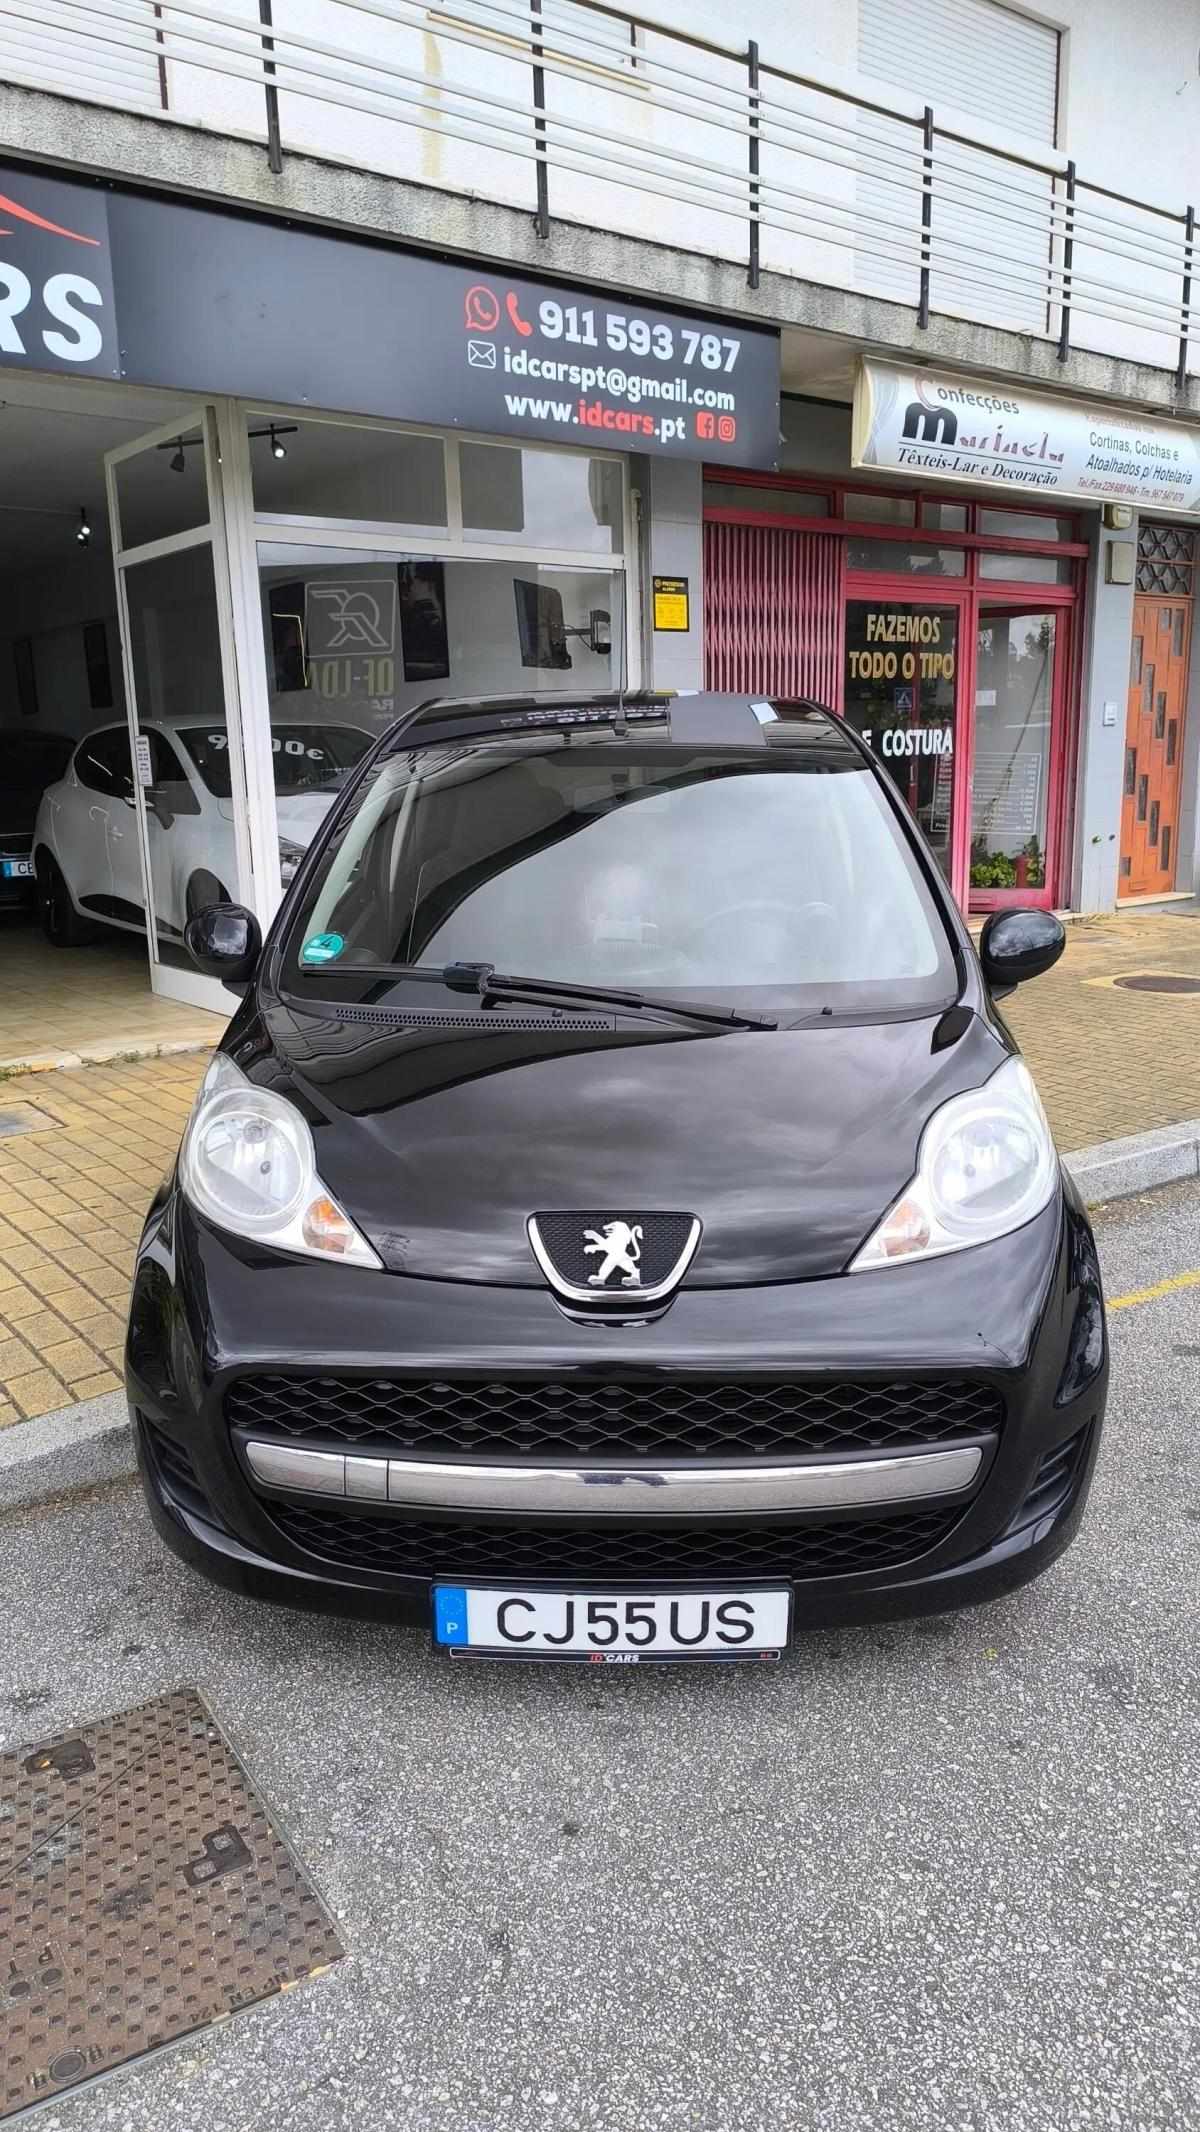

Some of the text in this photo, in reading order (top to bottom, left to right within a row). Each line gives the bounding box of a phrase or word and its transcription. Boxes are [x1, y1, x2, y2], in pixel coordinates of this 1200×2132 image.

[538, 300, 741, 373] 911 593 787
[503, 346, 735, 411] idcarspt@gmail.com
[504, 394, 686, 444] www.idcars.pt
[1089, 431, 1180, 462] Cortinas, Colchas e
[898, 447, 1058, 486] Têxteis-Lar e Decoração
[1086, 453, 1141, 477] Atoalhados
[1153, 466, 1193, 485] Hotelaria
[866, 614, 941, 643] FAZEMOS
[849, 651, 955, 679] TODO O TIPO
[882, 727, 954, 757] COSTURA
[446, 1622, 459, 1635] P
[496, 1597, 756, 1646] CJ55US
